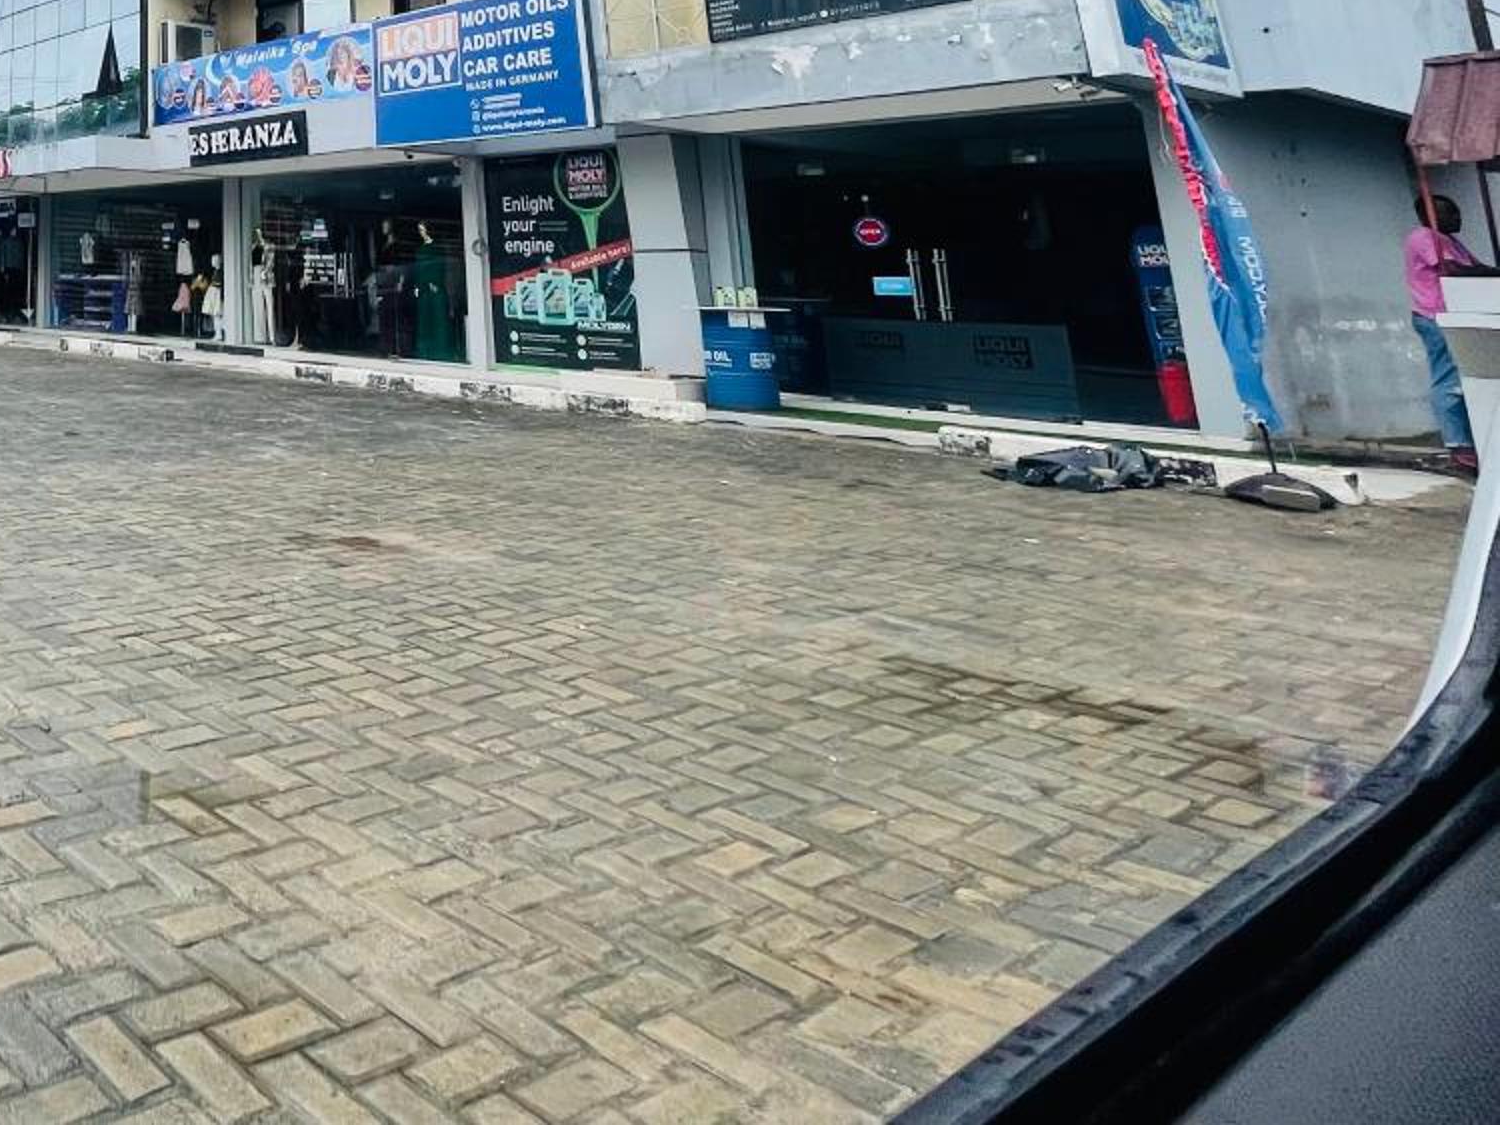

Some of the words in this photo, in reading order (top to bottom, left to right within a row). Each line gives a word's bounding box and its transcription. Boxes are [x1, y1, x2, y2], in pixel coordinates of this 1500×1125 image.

[461, 1, 521, 27] MOTOR
[382, 19, 453, 60] LIQUI
[462, 21, 555, 53] ADDITIVES
[383, 51, 457, 91] MOLY
[463, 56, 499, 77] CAR
[503, 47, 553, 71] CARE
[465, 79, 494, 91] MADE
[495, 78, 507, 88] IN
[508, 70, 559, 86] GERMANY
[567, 154, 604, 169] LIQUI
[568, 168, 604, 185] MOLY
[503, 195, 555, 215] Enlight
[503, 220, 536, 236] your
[505, 237, 555, 257] engine
[1137, 244, 1167, 255] LIQU
[1139, 254, 1170, 268] MOL
